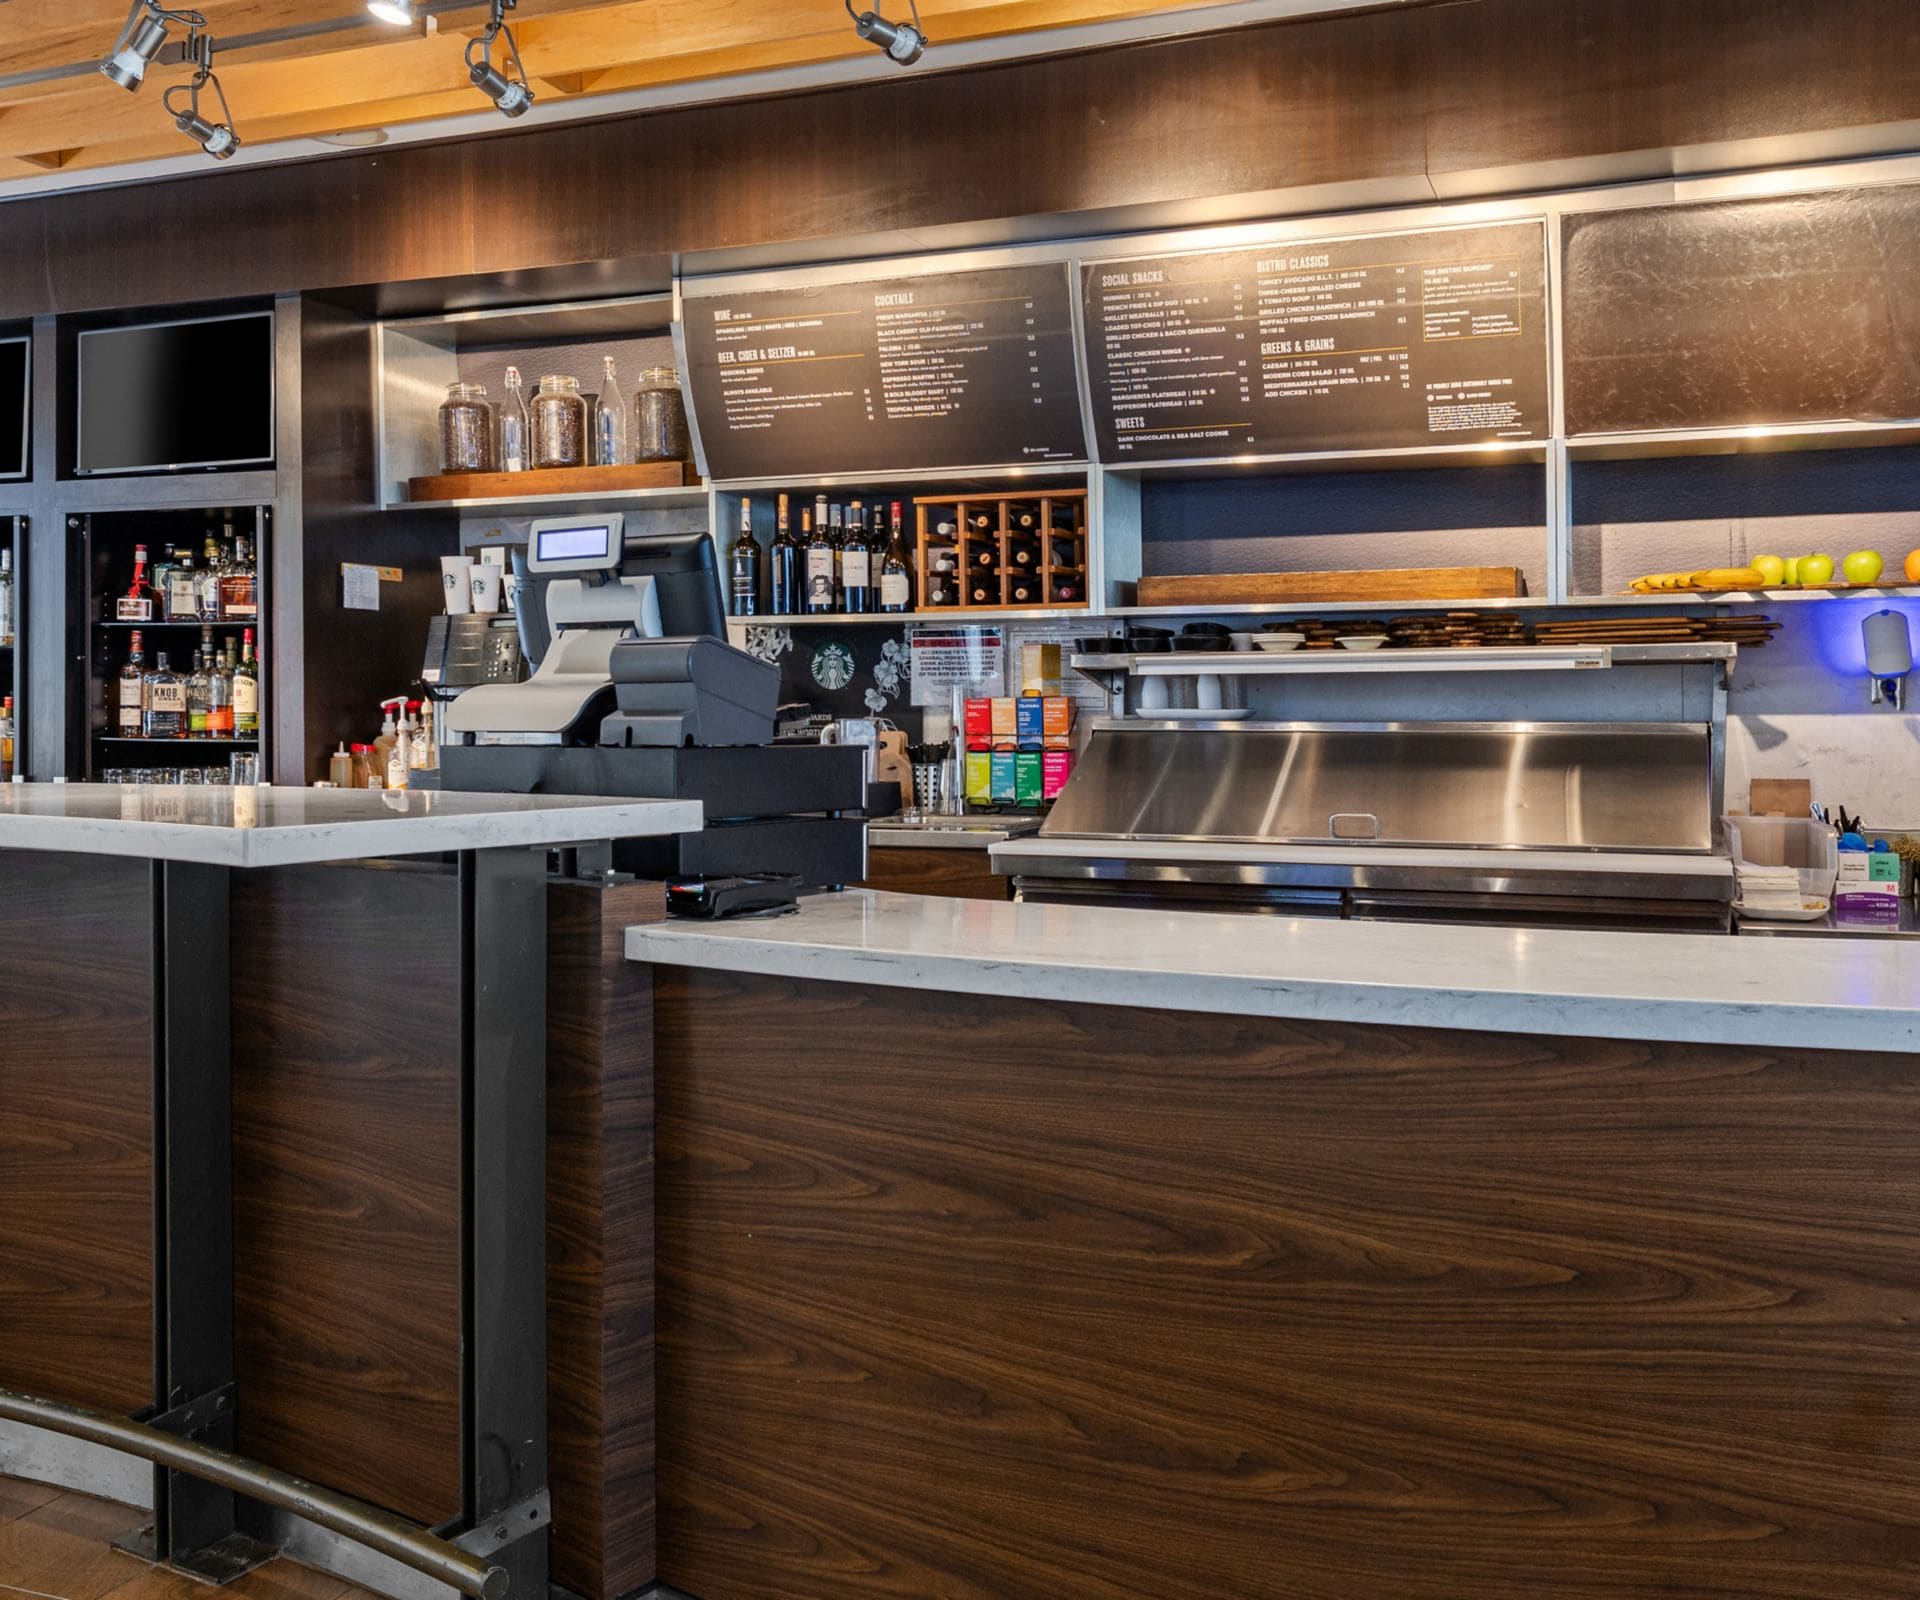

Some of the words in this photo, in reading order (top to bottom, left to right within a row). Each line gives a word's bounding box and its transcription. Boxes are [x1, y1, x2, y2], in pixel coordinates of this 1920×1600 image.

[1257, 259, 1286, 272] BISTRO
[1290, 255, 1329, 269] CLASSICS
[1103, 274, 1129, 287] SOCIAL
[1133, 271, 1163, 284] SNACKS
[1284, 275, 1315, 284] AVOCADO
[1258, 287, 1306, 296] THREE-CHEESE
[875, 293, 913, 306] COCKTAILS
[1104, 304, 1128, 312] FRENCH
[1259, 307, 1285, 316] GRILLED
[1286, 305, 1314, 313] CHICKEN
[1316, 302, 1351, 311] SANDWICH
[714, 310, 731, 321] WINE
[895, 311, 927, 320] MARGARITA
[1129, 311, 1164, 320] MEATBALLS
[1259, 318, 1288, 326] BUFFALO
[1310, 314, 1338, 322] CHICKEN
[1340, 311, 1375, 319] SANDWICH
[1188, 326, 1226, 335] QUESADILLA
[1261, 341, 1291, 355] GREENS
[1295, 340, 1302, 352] &
[1305, 338, 1335, 351] GRAINS
[718, 352, 736, 363] BEER,
[739, 350, 758, 361] CIDER
[760, 349, 766, 359] &
[768, 346, 795, 359] SELTZER
[1262, 362, 1288, 370] CAESAR
[1264, 380, 1317, 389] MEDITERRANEAN
[1112, 392, 1150, 401] MARGHERITA
[1152, 391, 1186, 399] FLATBREAD
[887, 405, 913, 413] TROPICAL
[1113, 402, 1147, 411] PEPPERONI
[1148, 400, 1182, 408] FLATBREAD
[1115, 416, 1145, 429] SWEETS
[154, 688, 178, 697] KNOB
